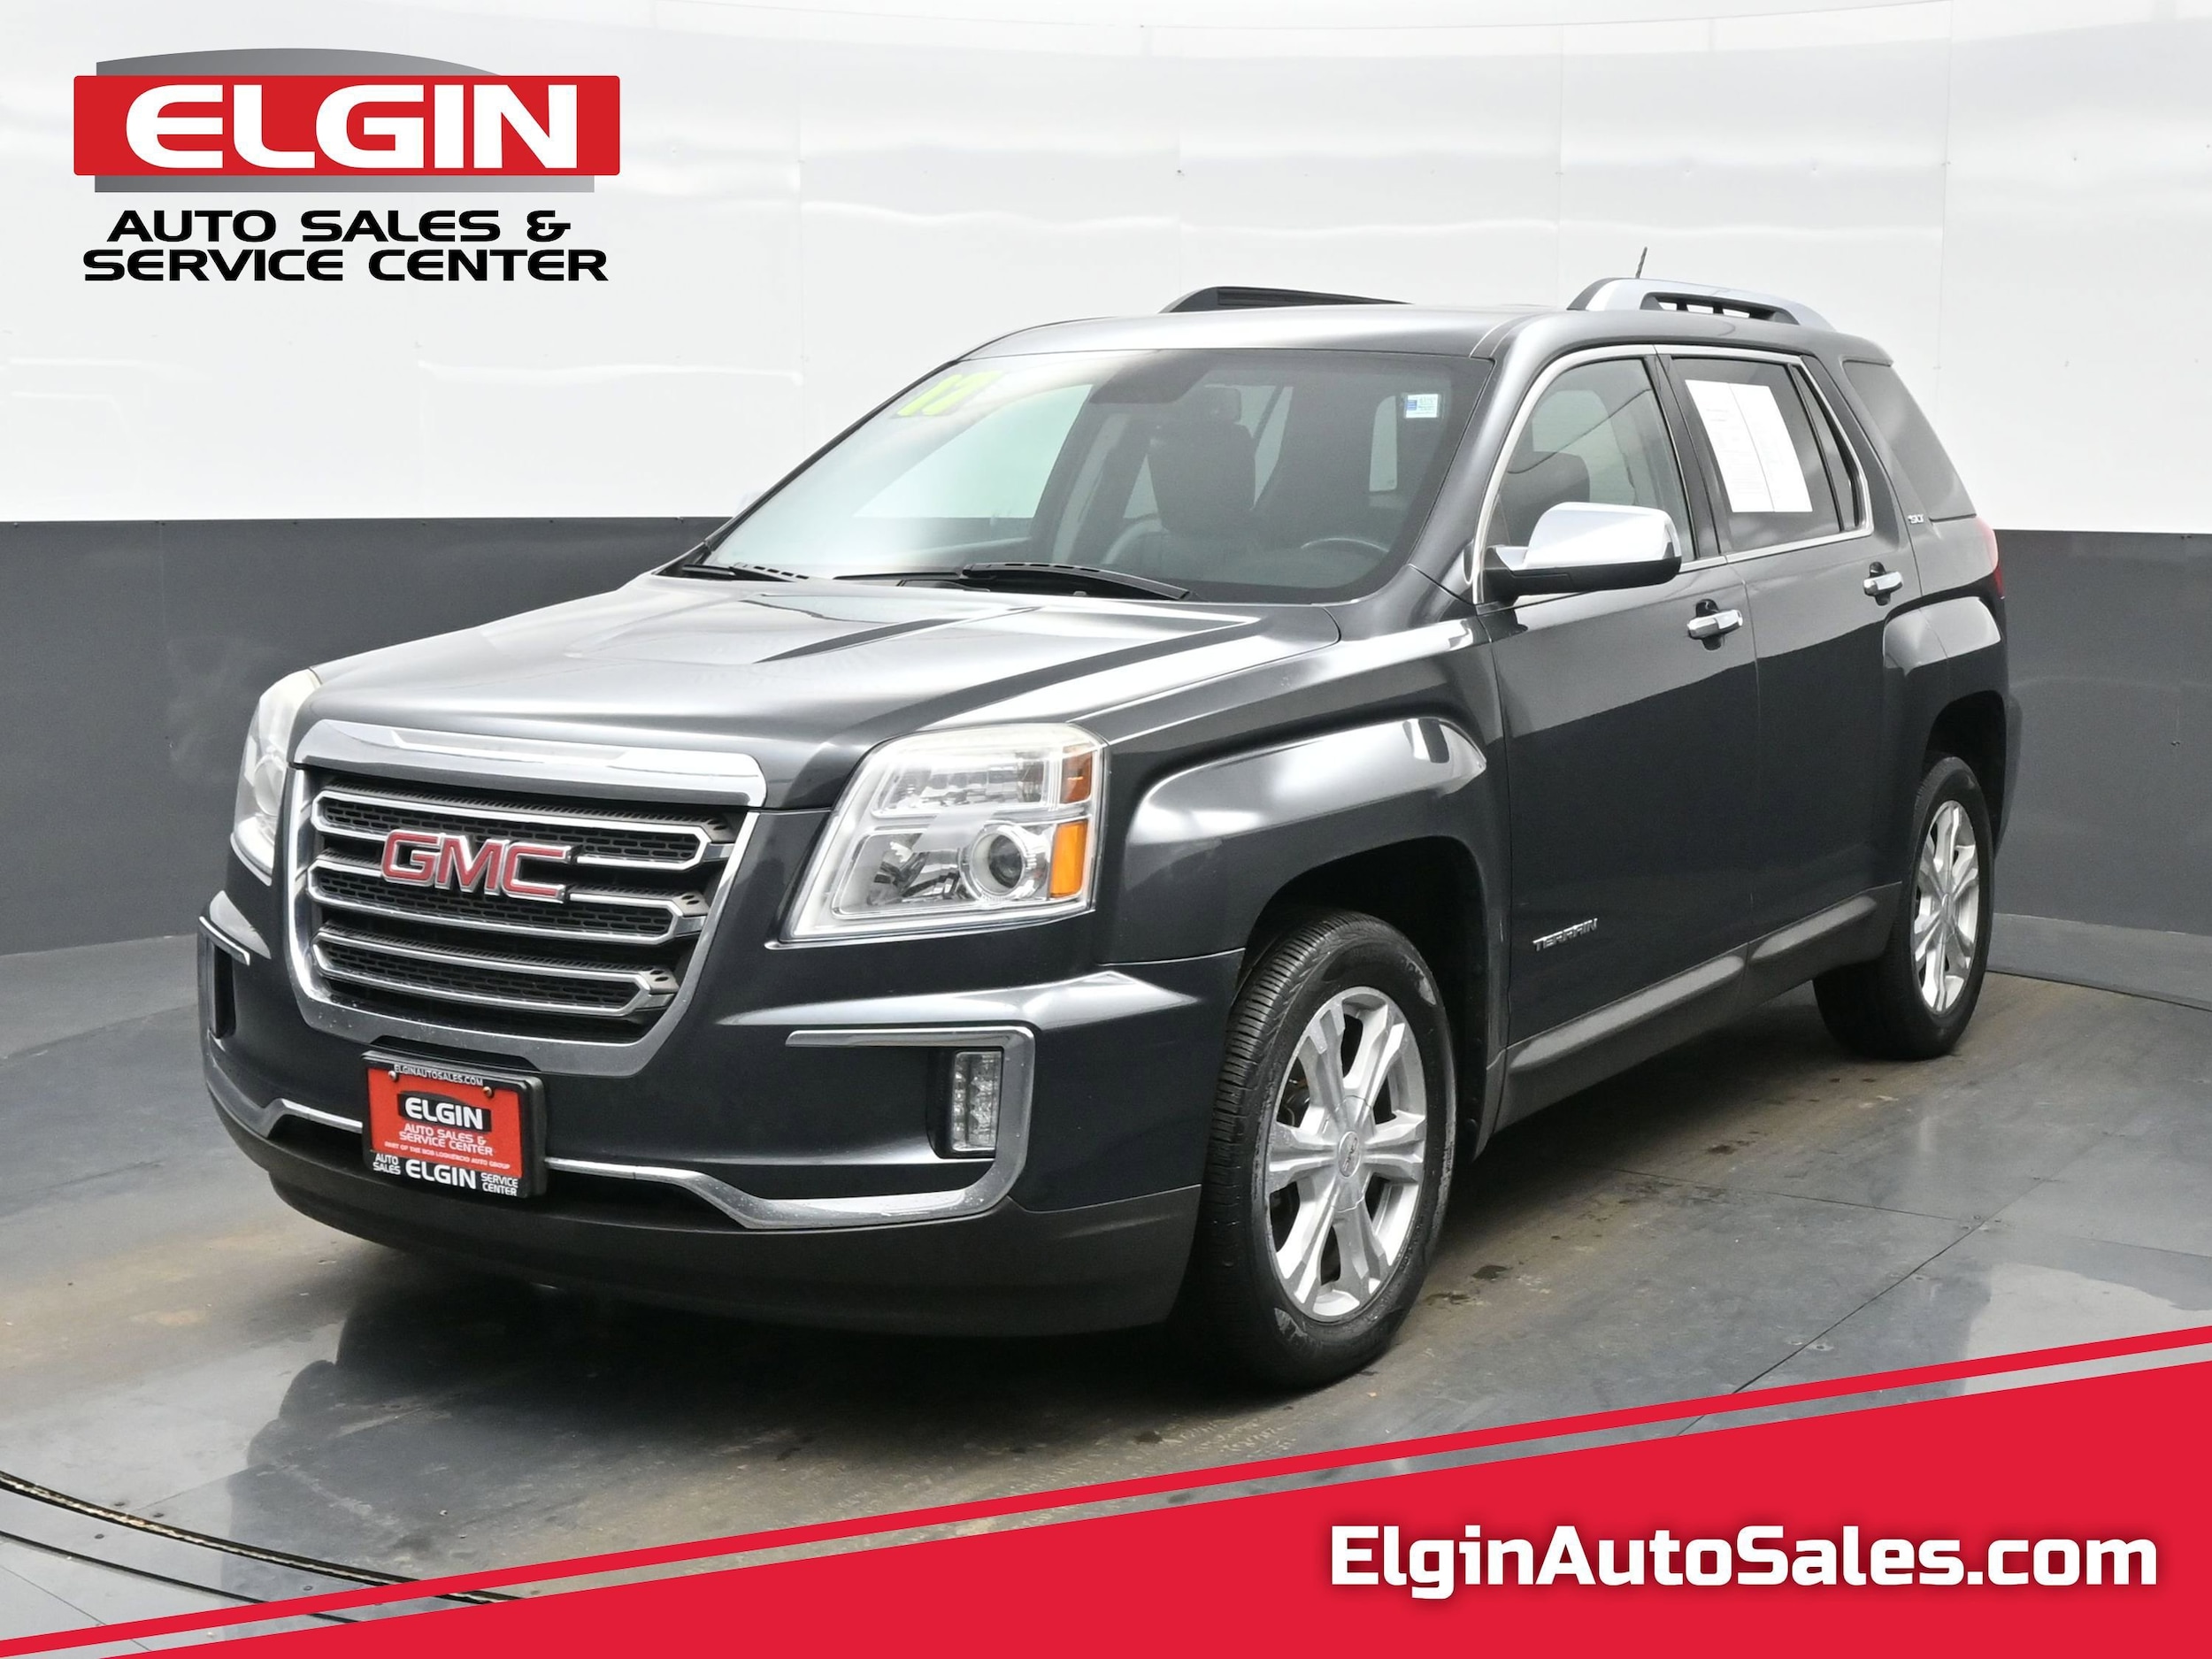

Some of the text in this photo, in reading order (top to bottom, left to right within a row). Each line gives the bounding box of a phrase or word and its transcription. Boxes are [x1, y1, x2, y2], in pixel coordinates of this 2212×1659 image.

[381, 829, 572, 903] GMC
[1532, 918, 1598, 951] TERRAIN
[394, 1064, 484, 1087] ELGINAUTOSALES.COM
[405, 1097, 483, 1130] ELGIN
[399, 1131, 494, 1156] SERVICE CENTER
[403, 1123, 487, 1146] AUTO SALES &
[373, 1162, 401, 1175] SALES
[374, 1153, 399, 1165] AUTO
[405, 1159, 476, 1189] ELGIN
[480, 1172, 518, 1189] SERVICE
[482, 1182, 518, 1196] CENTER
